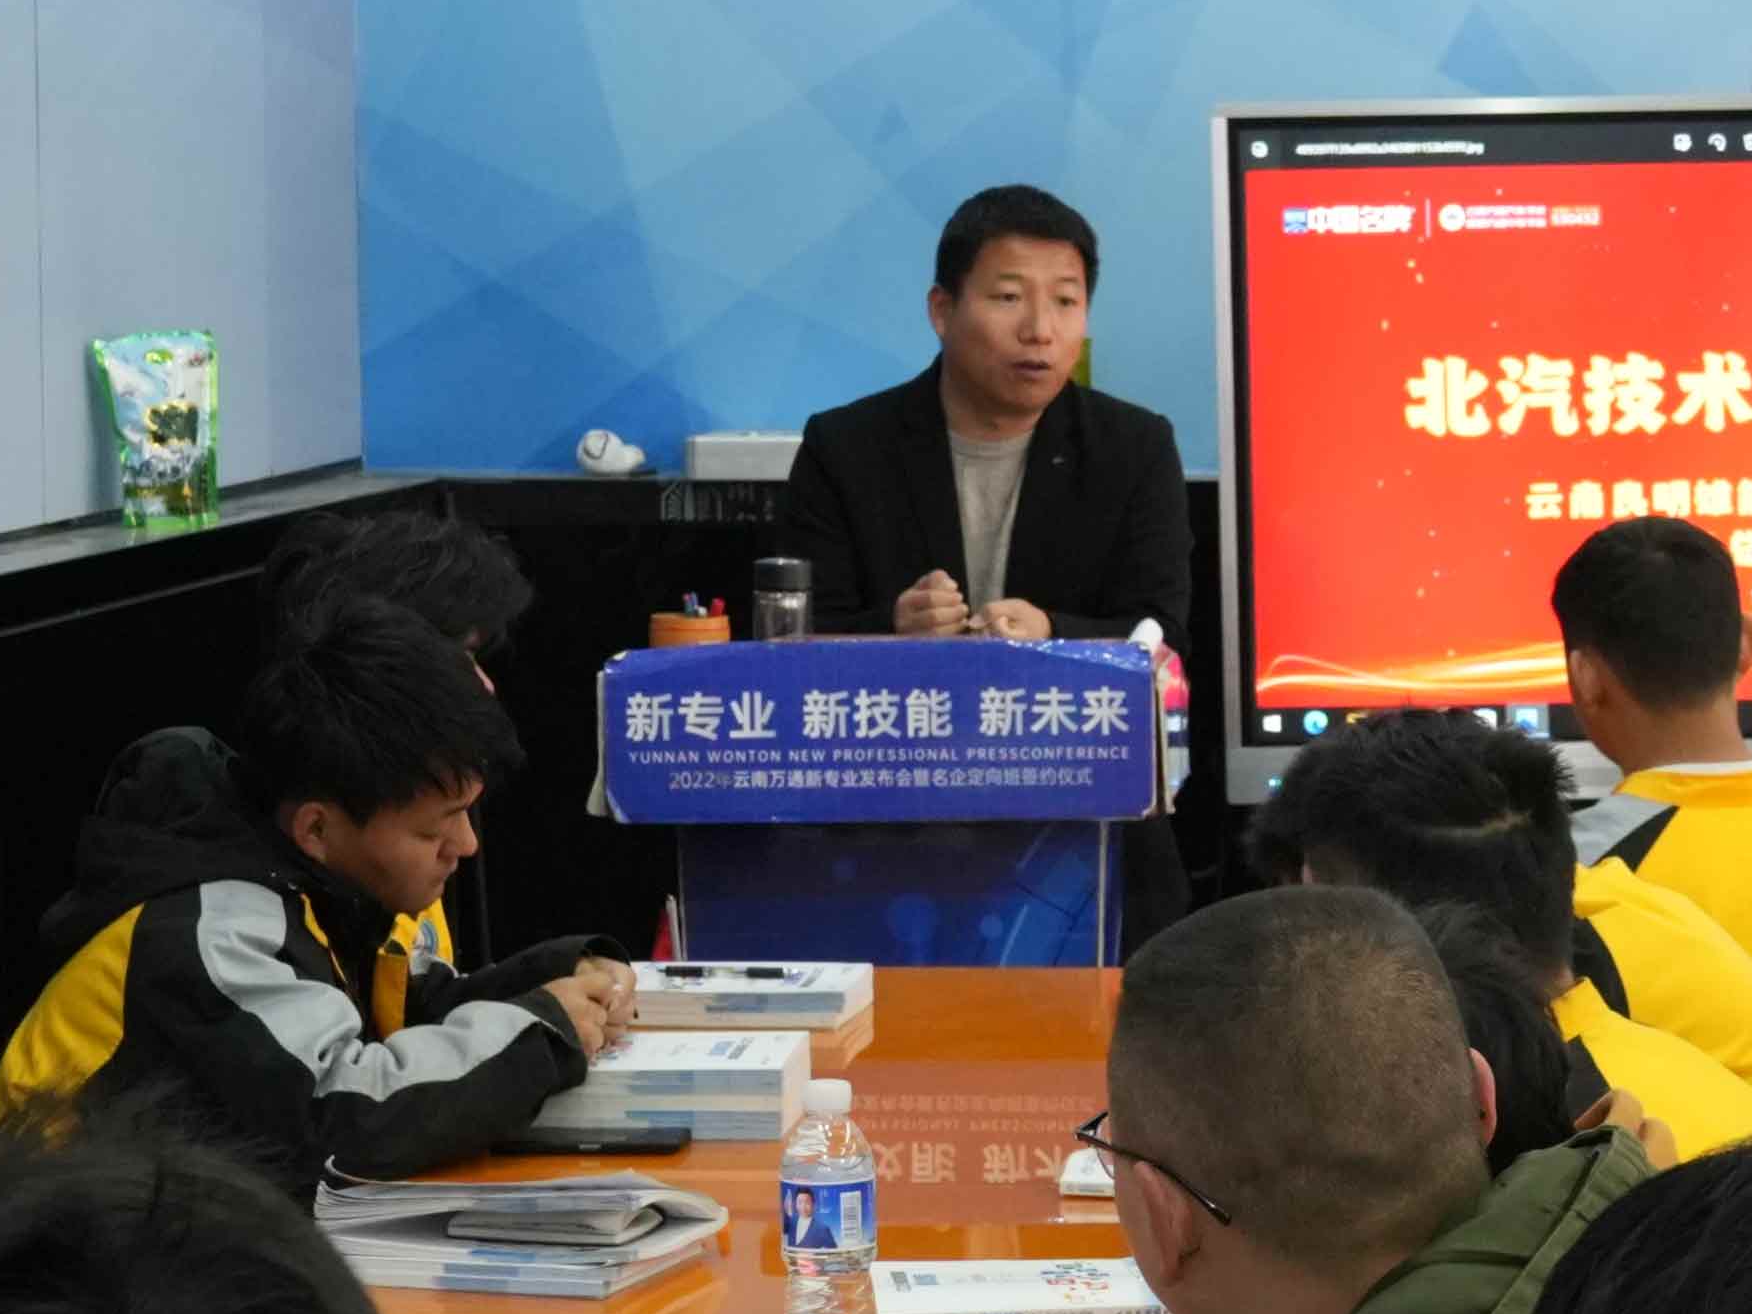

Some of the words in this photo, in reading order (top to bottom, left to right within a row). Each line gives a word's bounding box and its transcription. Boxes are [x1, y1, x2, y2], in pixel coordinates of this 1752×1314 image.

[625, 692, 777, 742] 新专业
[802, 688, 953, 740] 新技能
[979, 686, 1129, 738] 新未来
[629, 751, 701, 764] YUNNAN
[707, 750, 783, 763] WONTON
[789, 750, 826, 763] NEW
[833, 748, 959, 762] PROFESSIONAL
[967, 746, 1130, 761] PRESSCONFERENCE
